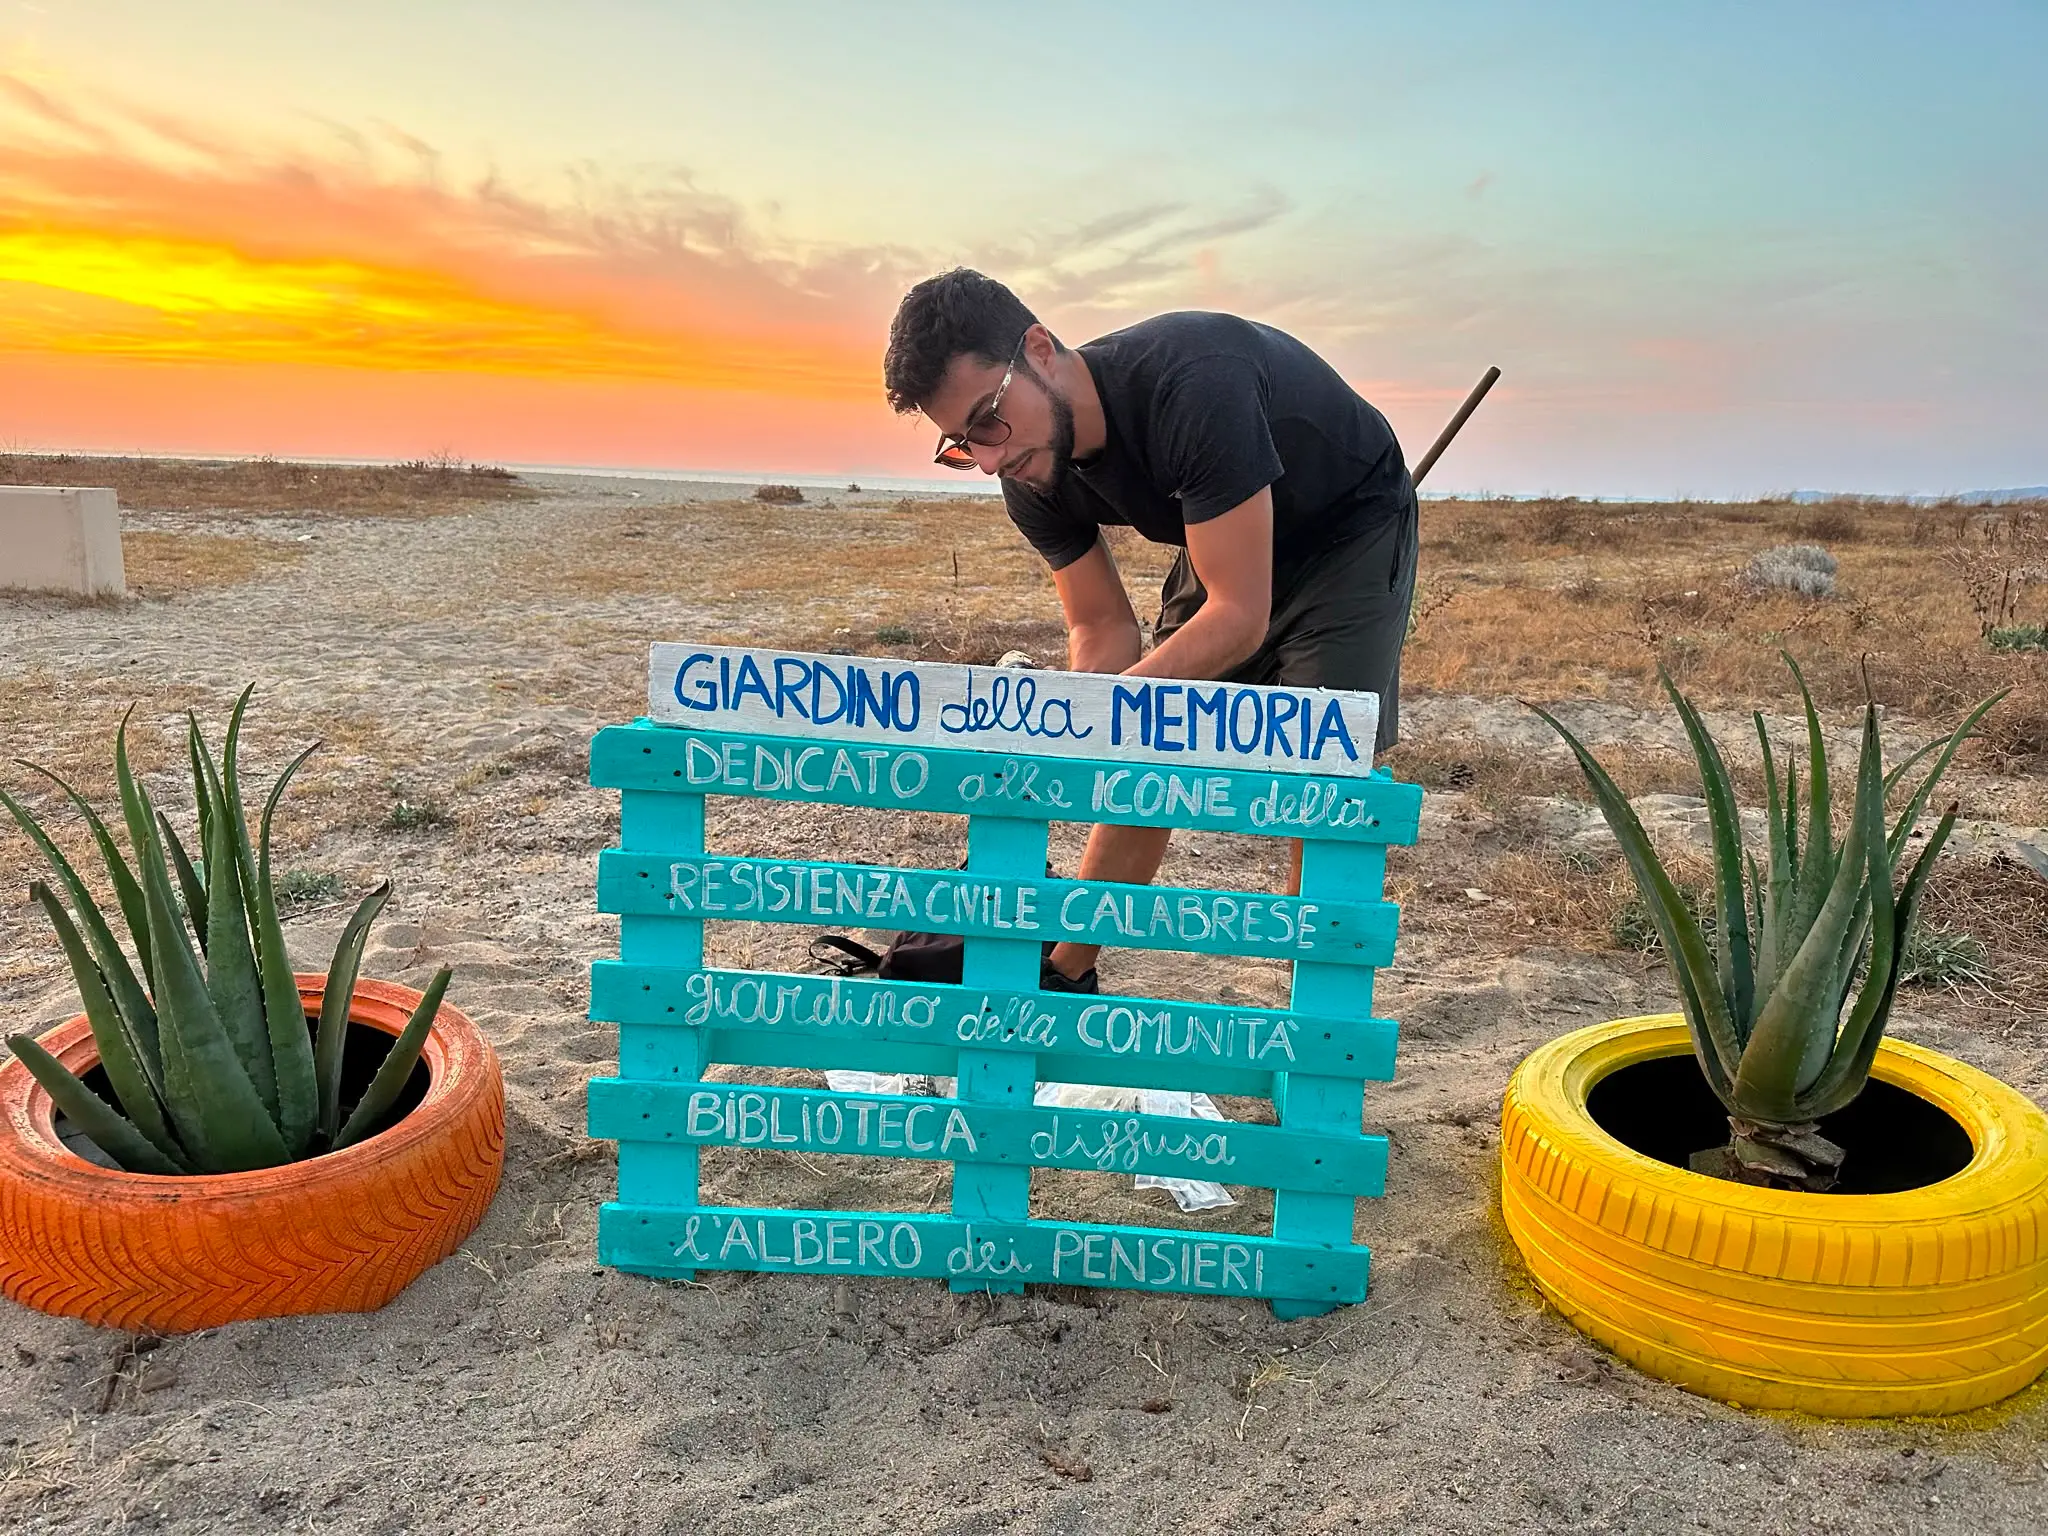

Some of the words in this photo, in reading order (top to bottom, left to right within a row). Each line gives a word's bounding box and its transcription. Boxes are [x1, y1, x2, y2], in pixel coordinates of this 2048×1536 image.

[674, 653, 920, 732] GIARDINO
[940, 667, 1093, 739] della
[1111, 683, 1359, 761] MEMORIA
[685, 738, 929, 798] DEDICATO
[957, 758, 1072, 808] alle
[1091, 769, 1237, 817] ICONE
[1249, 779, 1374, 828] della
[668, 862, 917, 918] RESISTENZA
[925, 880, 1040, 930] CIVILE
[1060, 888, 1319, 950] CALABRESE
[684, 973, 941, 1028] giardino
[956, 995, 1058, 1046] della
[1030, 1114, 1236, 1171] diffusa
[673, 1215, 923, 1270] l'ALBERO
[946, 1223, 1032, 1275] dei
[1053, 1230, 1264, 1292] PENSIERI
